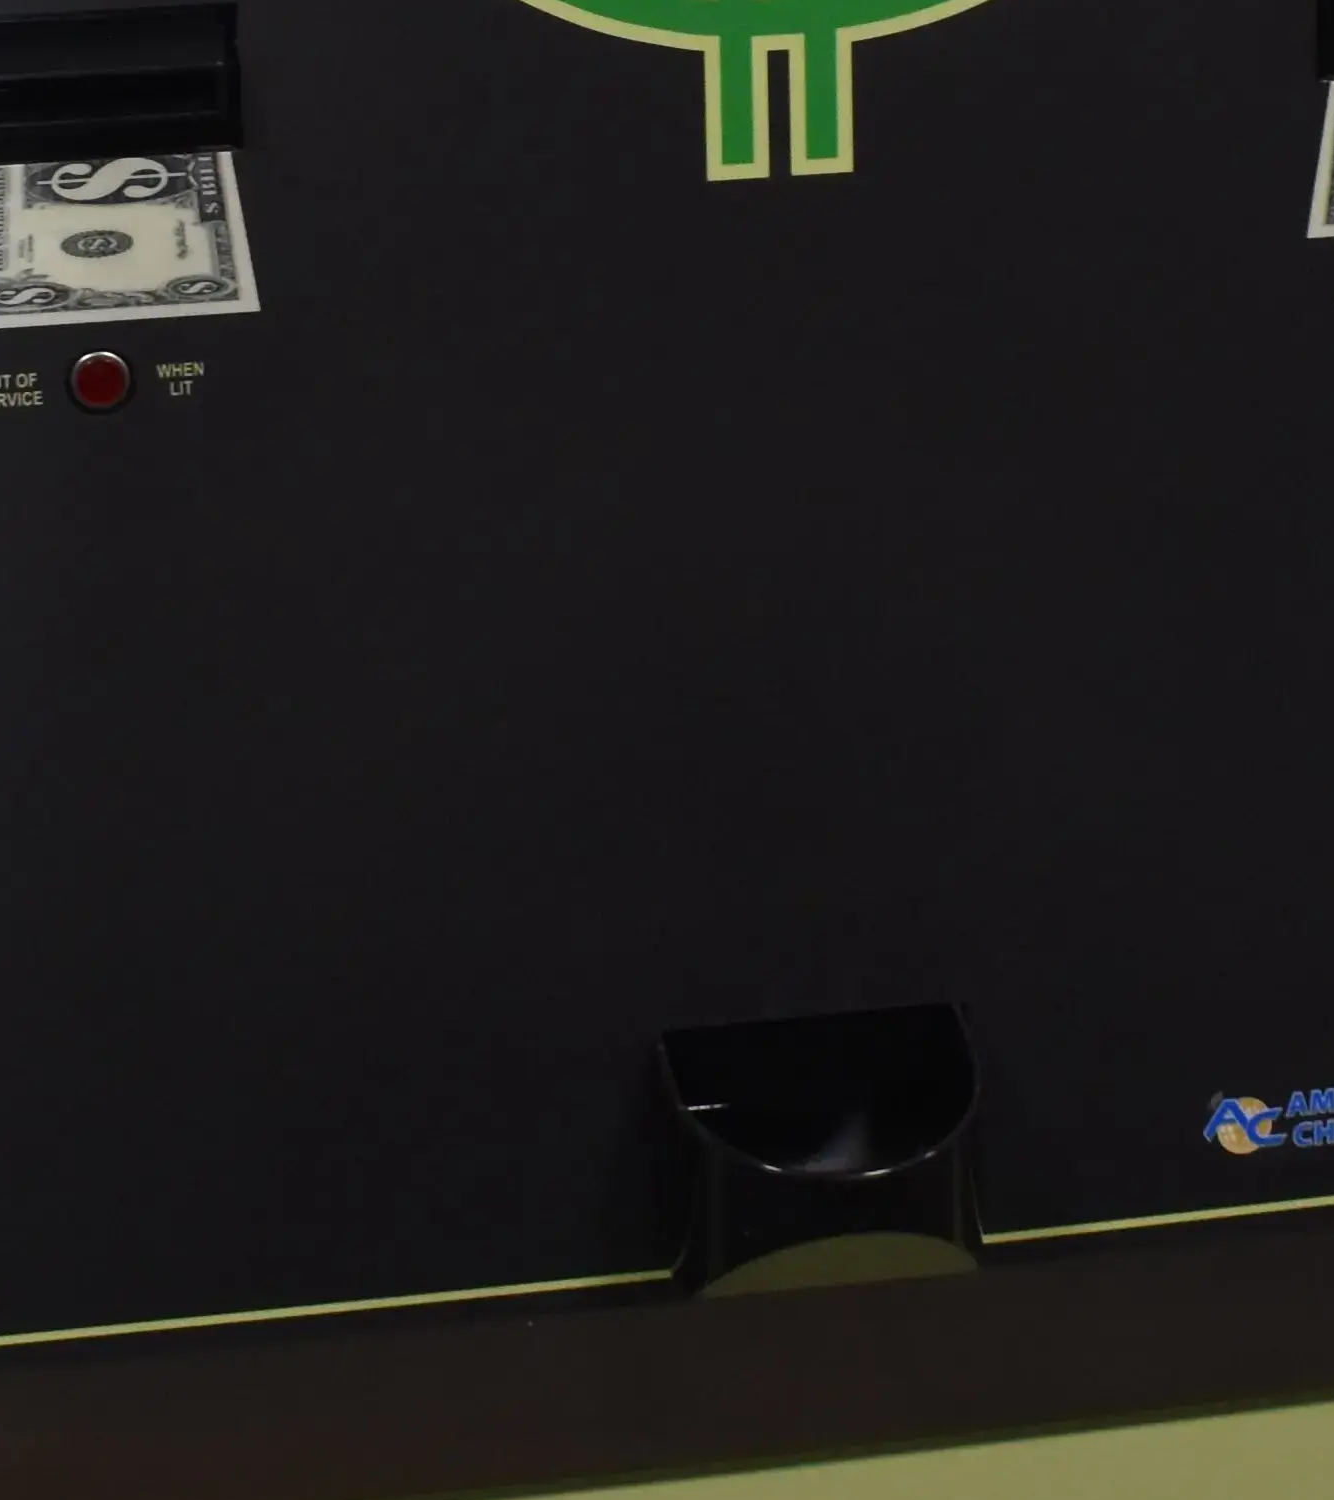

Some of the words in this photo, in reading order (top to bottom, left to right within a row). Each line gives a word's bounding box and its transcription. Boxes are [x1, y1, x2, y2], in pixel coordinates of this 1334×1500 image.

[156, 361, 205, 379] WHEN
[16, 372, 38, 388] OF
[169, 380, 193, 396] LIT
